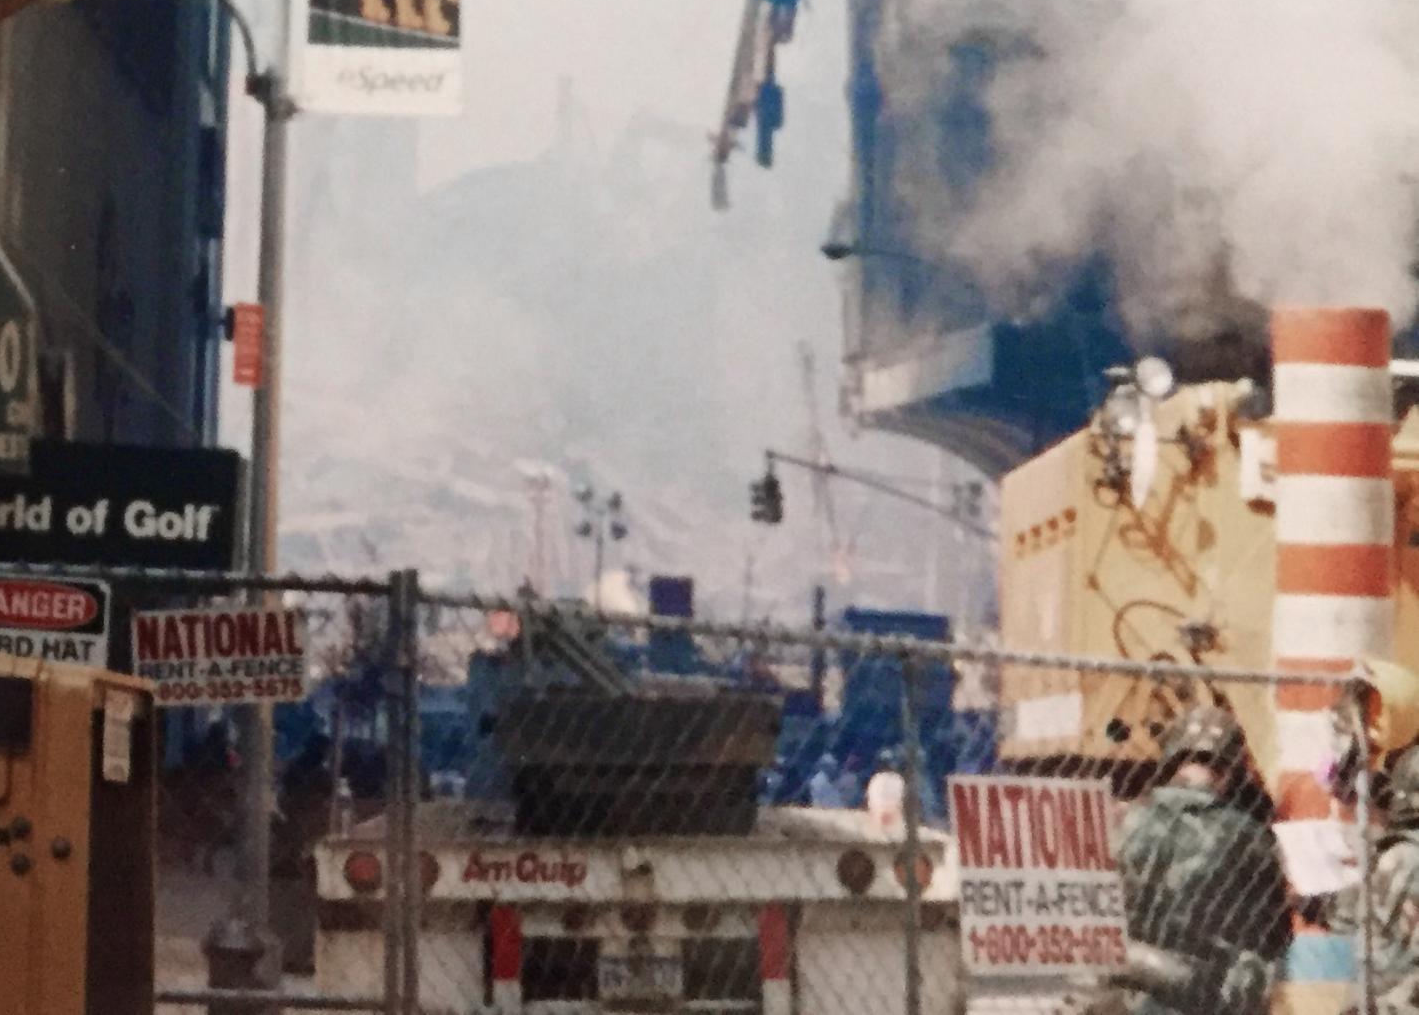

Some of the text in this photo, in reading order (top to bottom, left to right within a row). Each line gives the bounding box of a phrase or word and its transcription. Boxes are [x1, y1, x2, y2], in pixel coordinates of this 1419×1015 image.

[66, 498, 109, 535] of
[123, 499, 218, 542] Golf
[42, 638, 96, 662] HAT
[136, 613, 304, 660] NATIONAL
[953, 783, 1118, 870] NATIONAL
[462, 849, 588, 888] AmQuip
[961, 879, 1122, 917] RENT-A-FENCE
